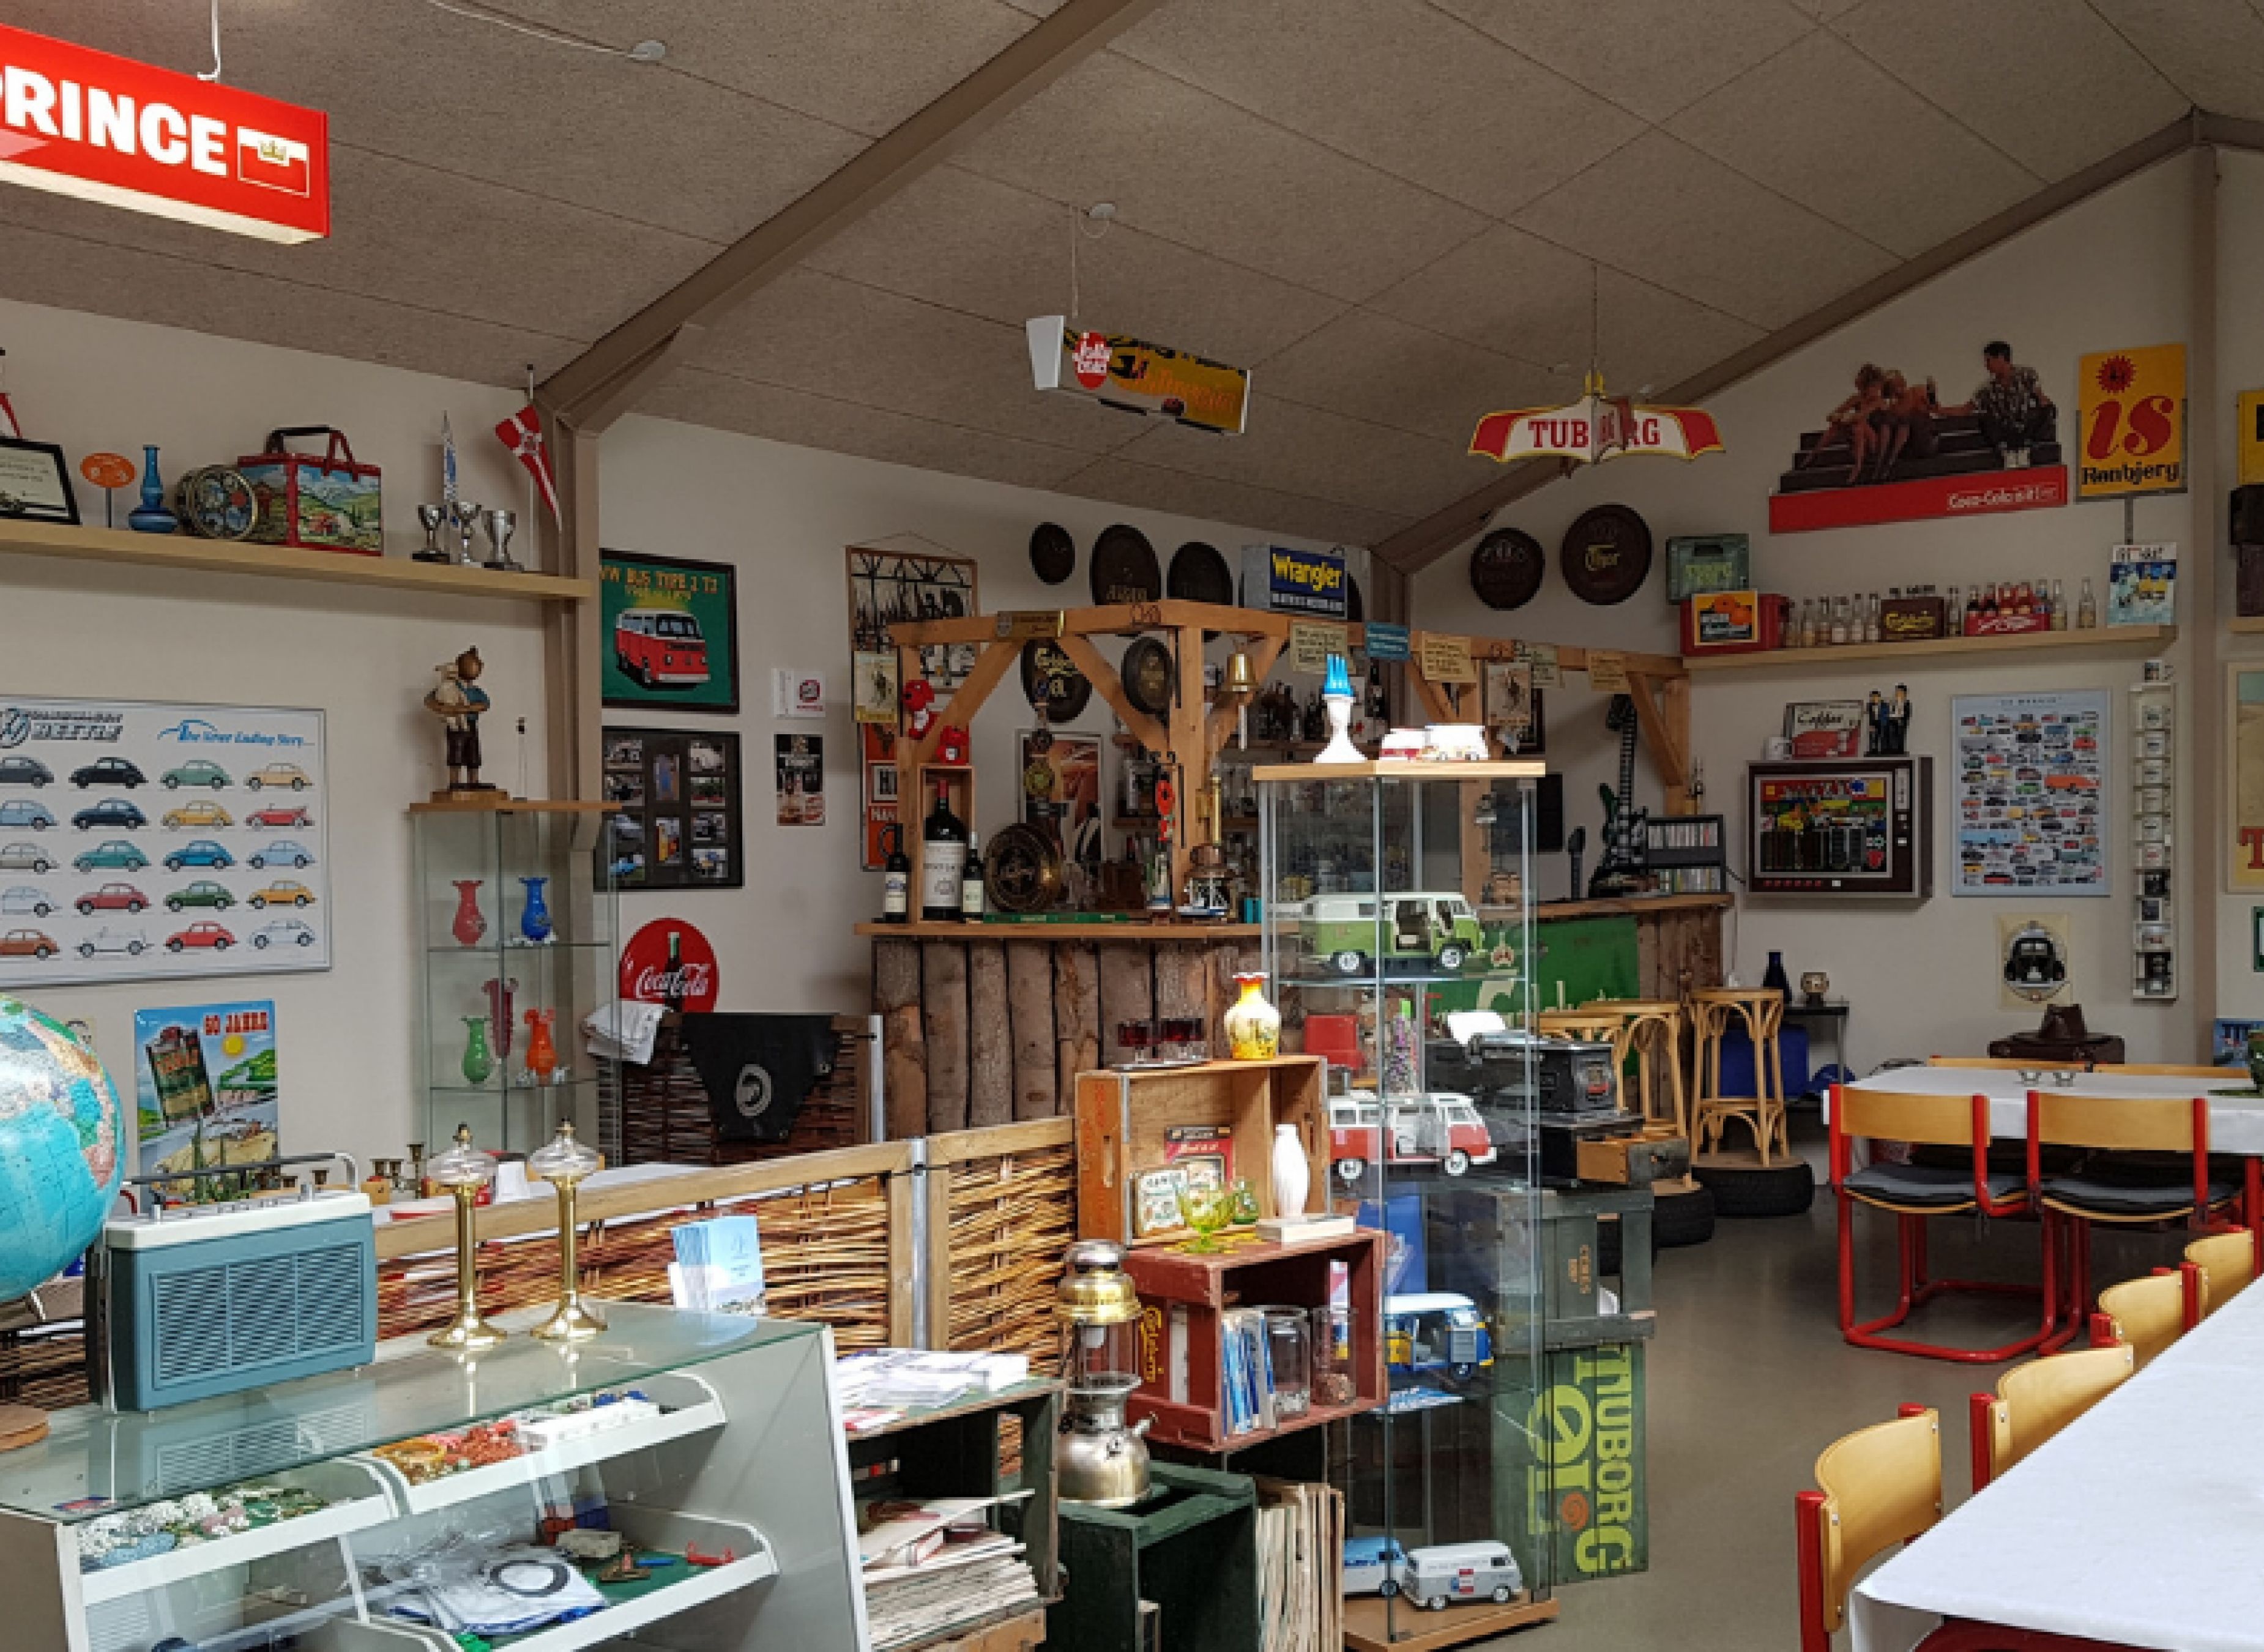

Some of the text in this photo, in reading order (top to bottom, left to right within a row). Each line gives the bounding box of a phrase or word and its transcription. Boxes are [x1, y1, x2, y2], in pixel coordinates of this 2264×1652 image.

[0, 64, 228, 176] RINCE
[1272, 554, 1342, 592] Wrangler
[1573, 1344, 1635, 1574] TUBORG
